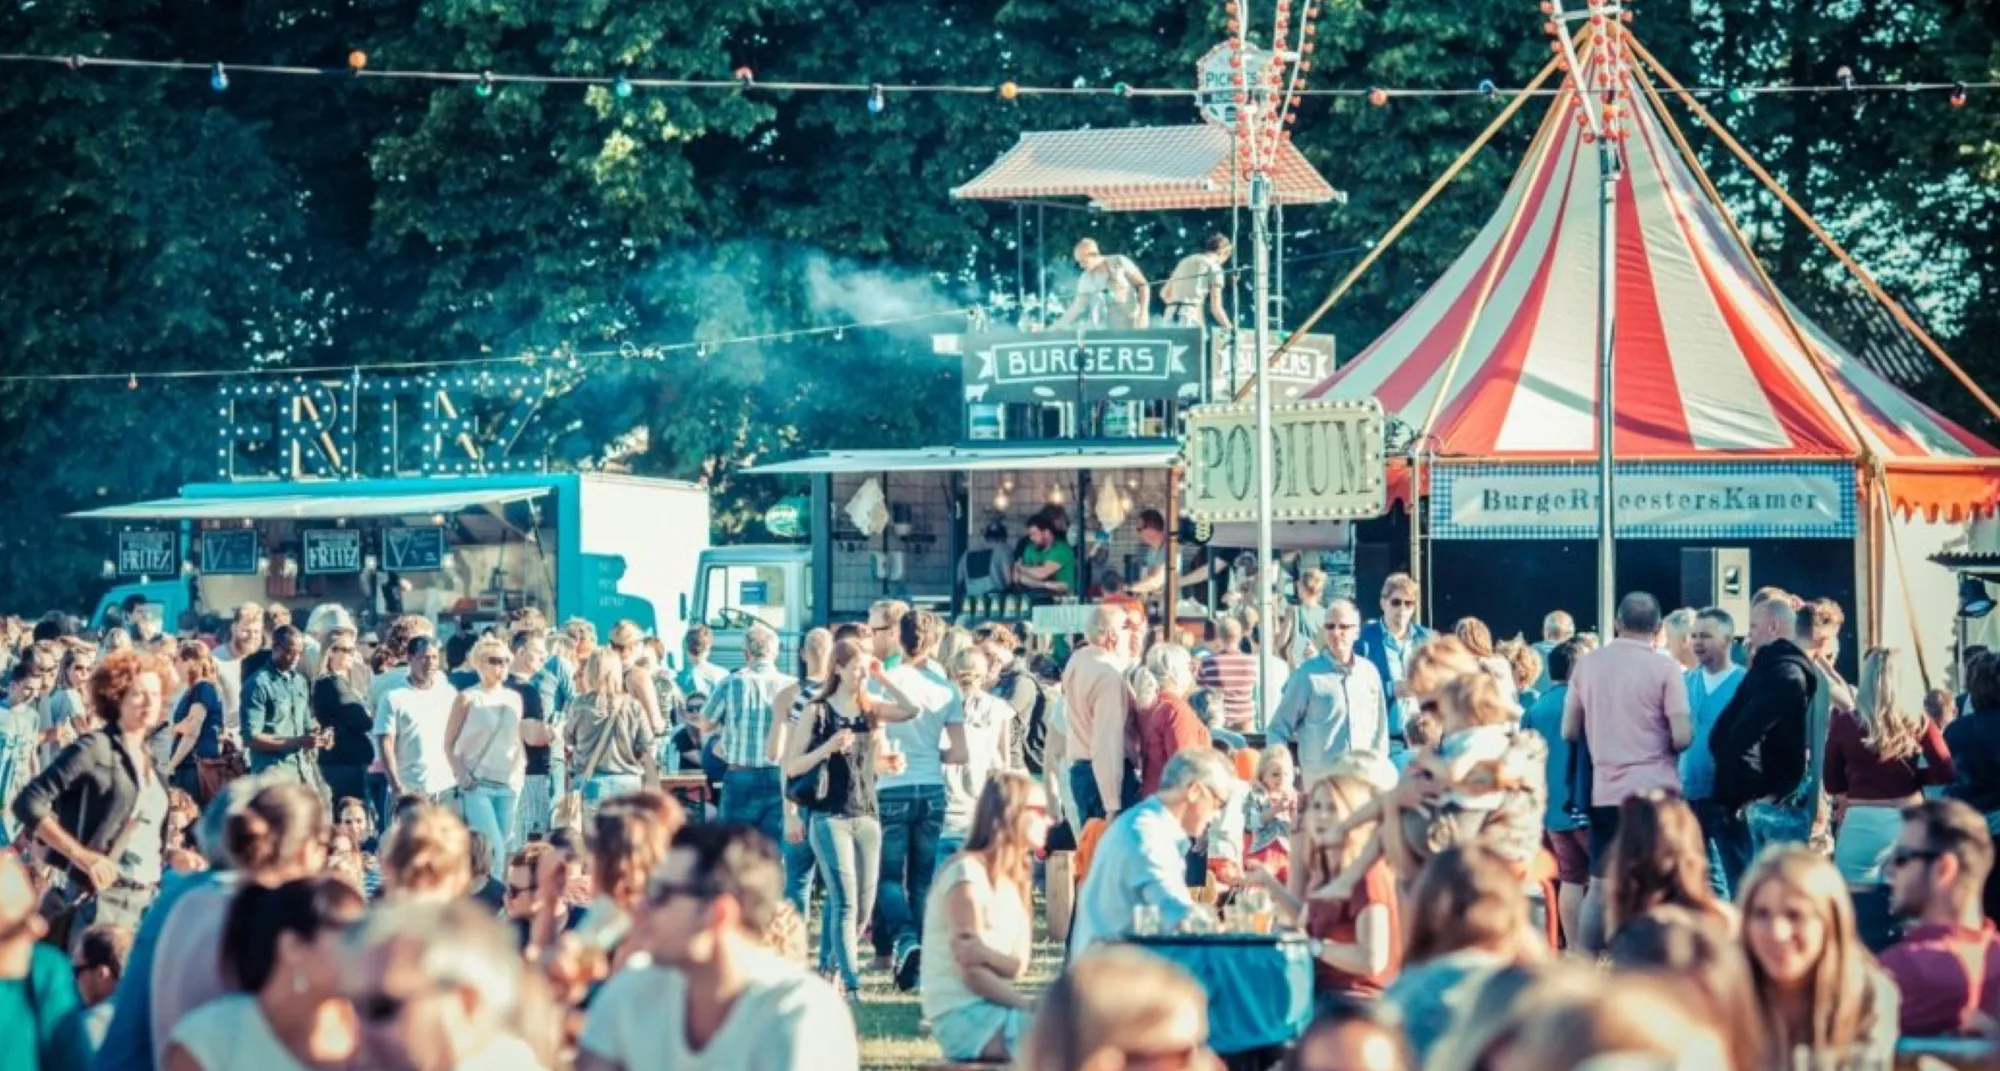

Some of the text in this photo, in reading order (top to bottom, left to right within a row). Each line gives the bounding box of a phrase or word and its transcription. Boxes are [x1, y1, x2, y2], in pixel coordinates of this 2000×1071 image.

[1008, 347, 1155, 376] BURGERS
[1198, 418, 1373, 500] PODIUM
[1482, 486, 1817, 515] BurgeReestersKamer
